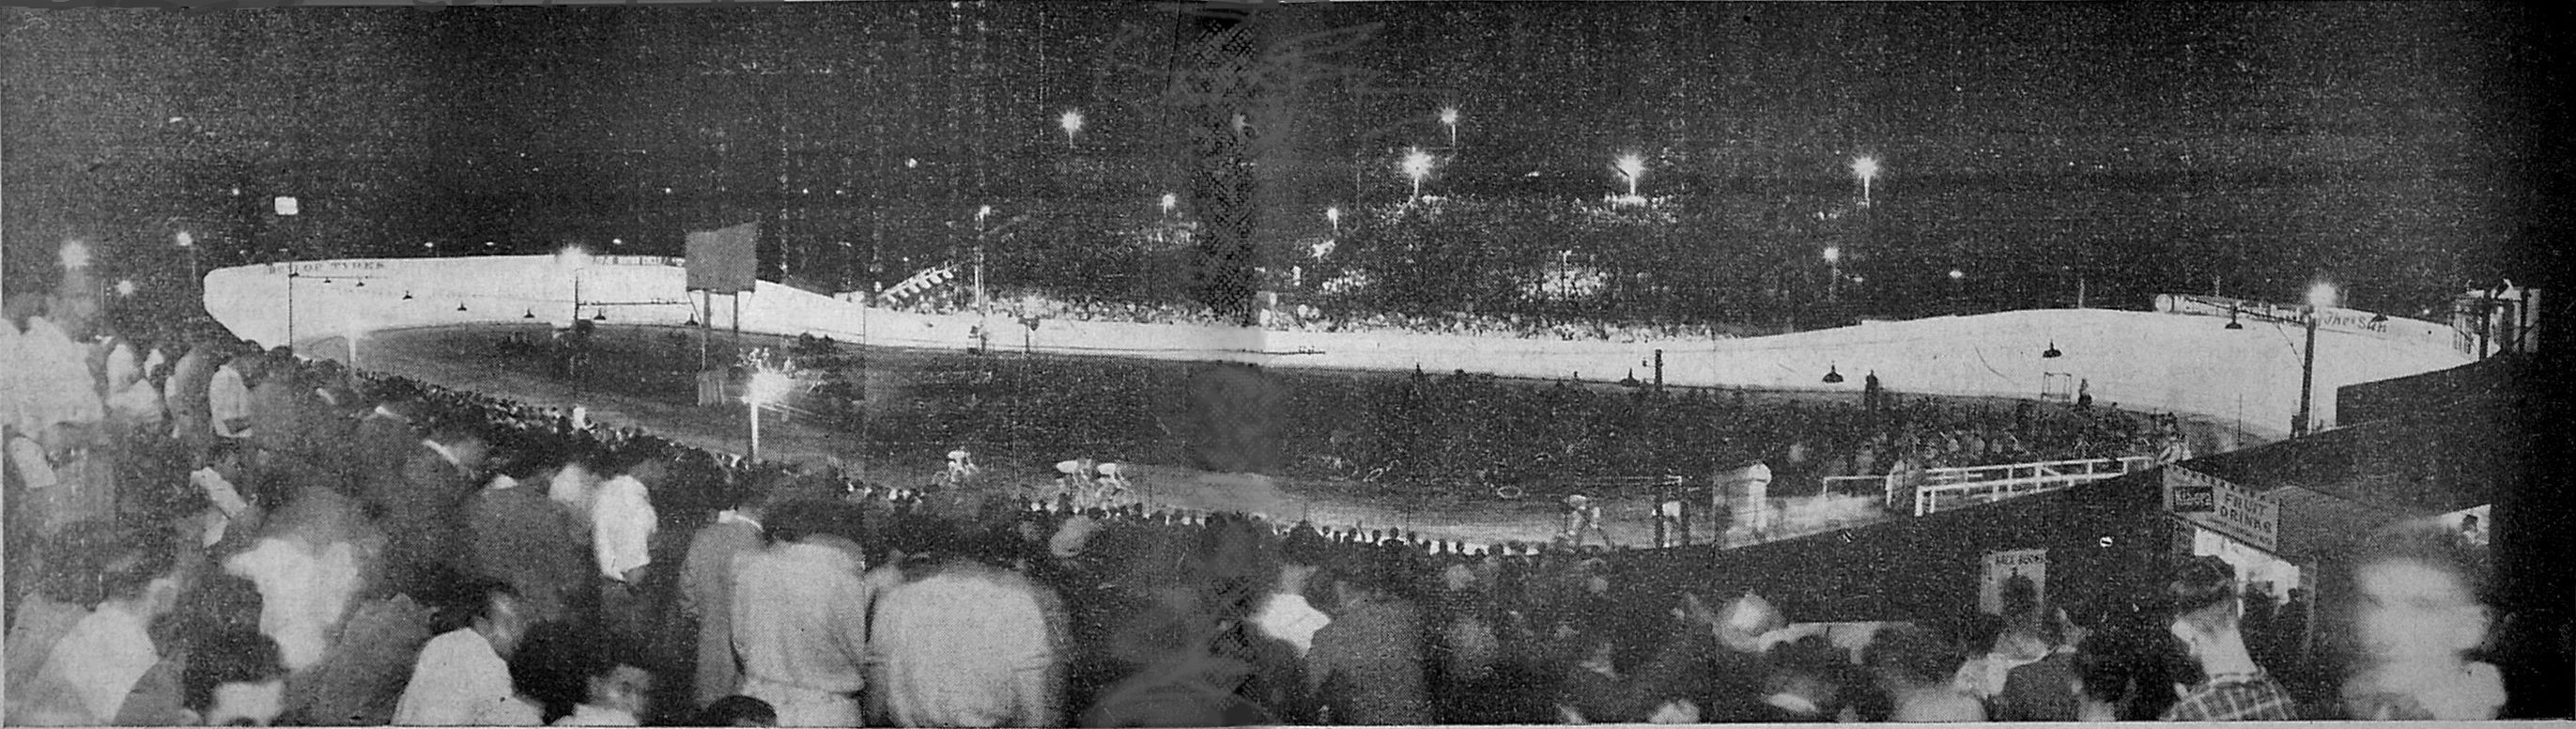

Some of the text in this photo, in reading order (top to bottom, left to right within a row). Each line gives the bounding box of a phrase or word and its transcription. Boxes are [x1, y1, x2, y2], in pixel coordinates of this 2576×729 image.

[2323, 311, 2388, 333] The Sun
[2225, 492, 2268, 517] FRUIT
[2219, 505, 2273, 535] DRINKS
